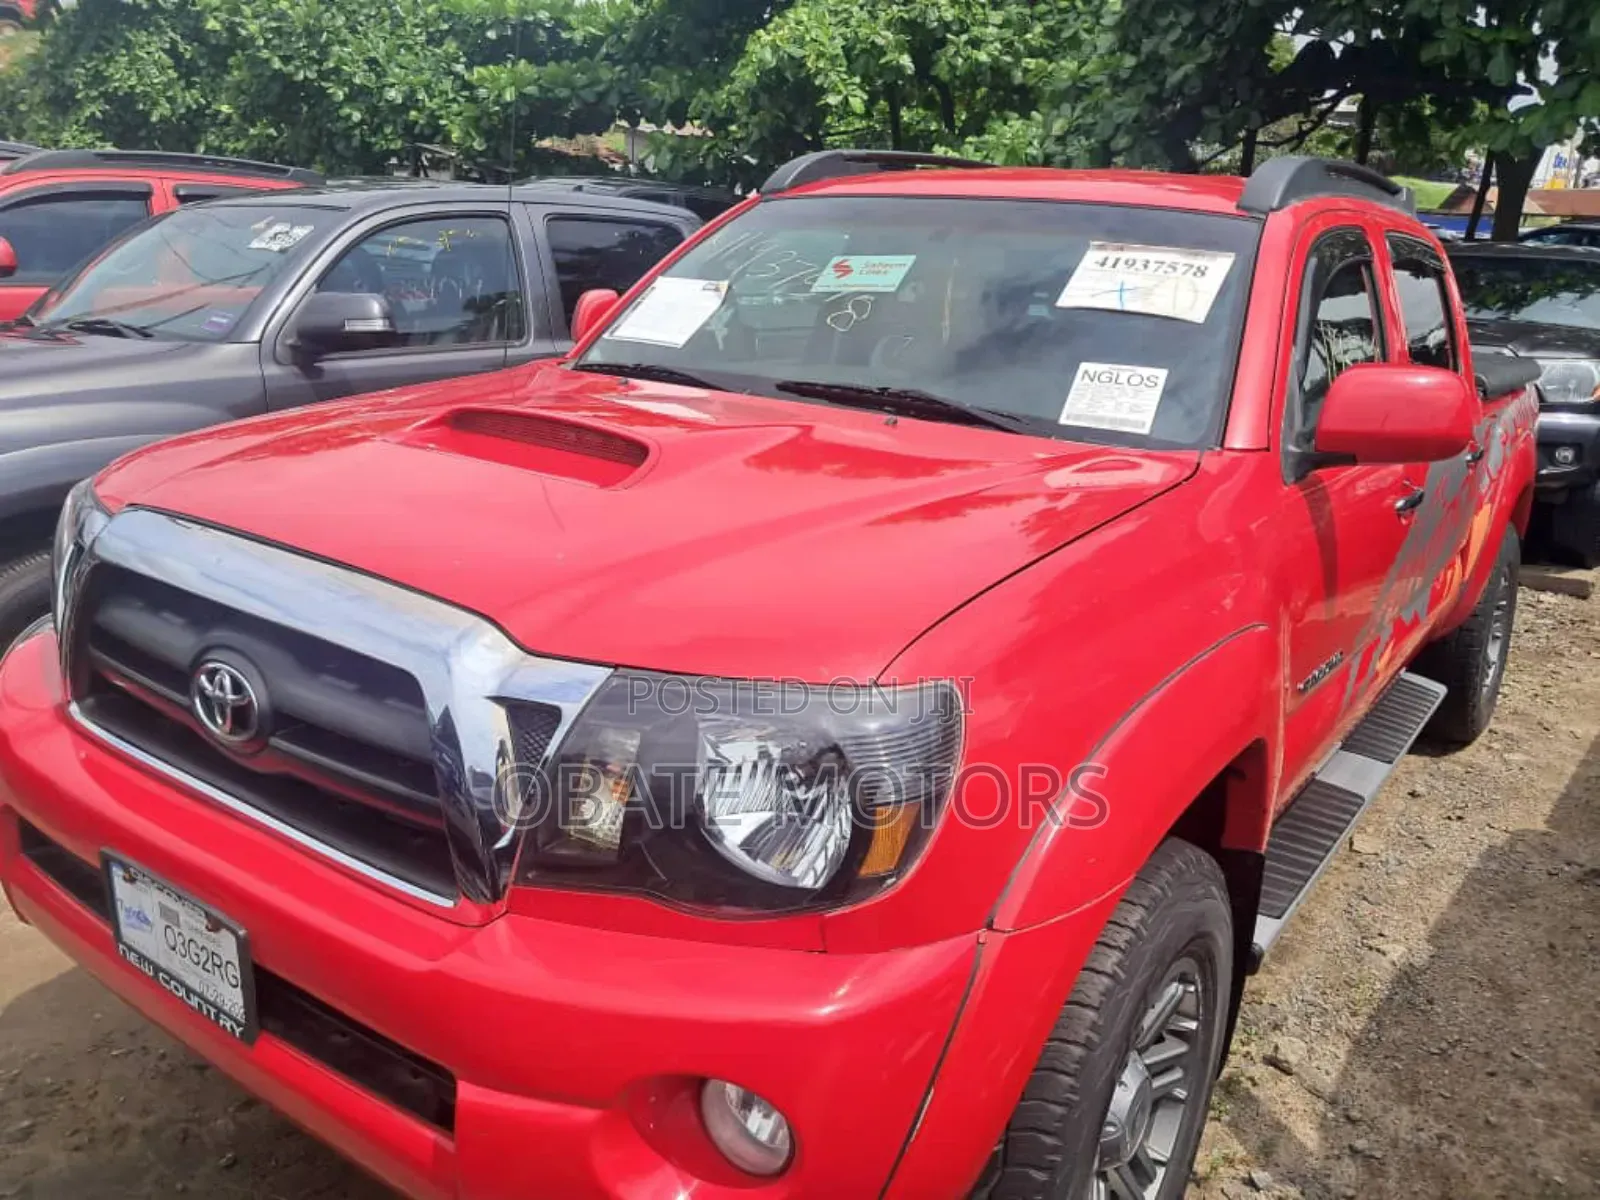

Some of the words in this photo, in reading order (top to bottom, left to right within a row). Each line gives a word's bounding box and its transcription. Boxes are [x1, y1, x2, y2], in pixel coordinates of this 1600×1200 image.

[1094, 255, 1209, 278] 41937578
[1081, 369, 1159, 389] NGLOS
[118, 944, 153, 978] NEW
[163, 924, 240, 989] Q3G2RG
